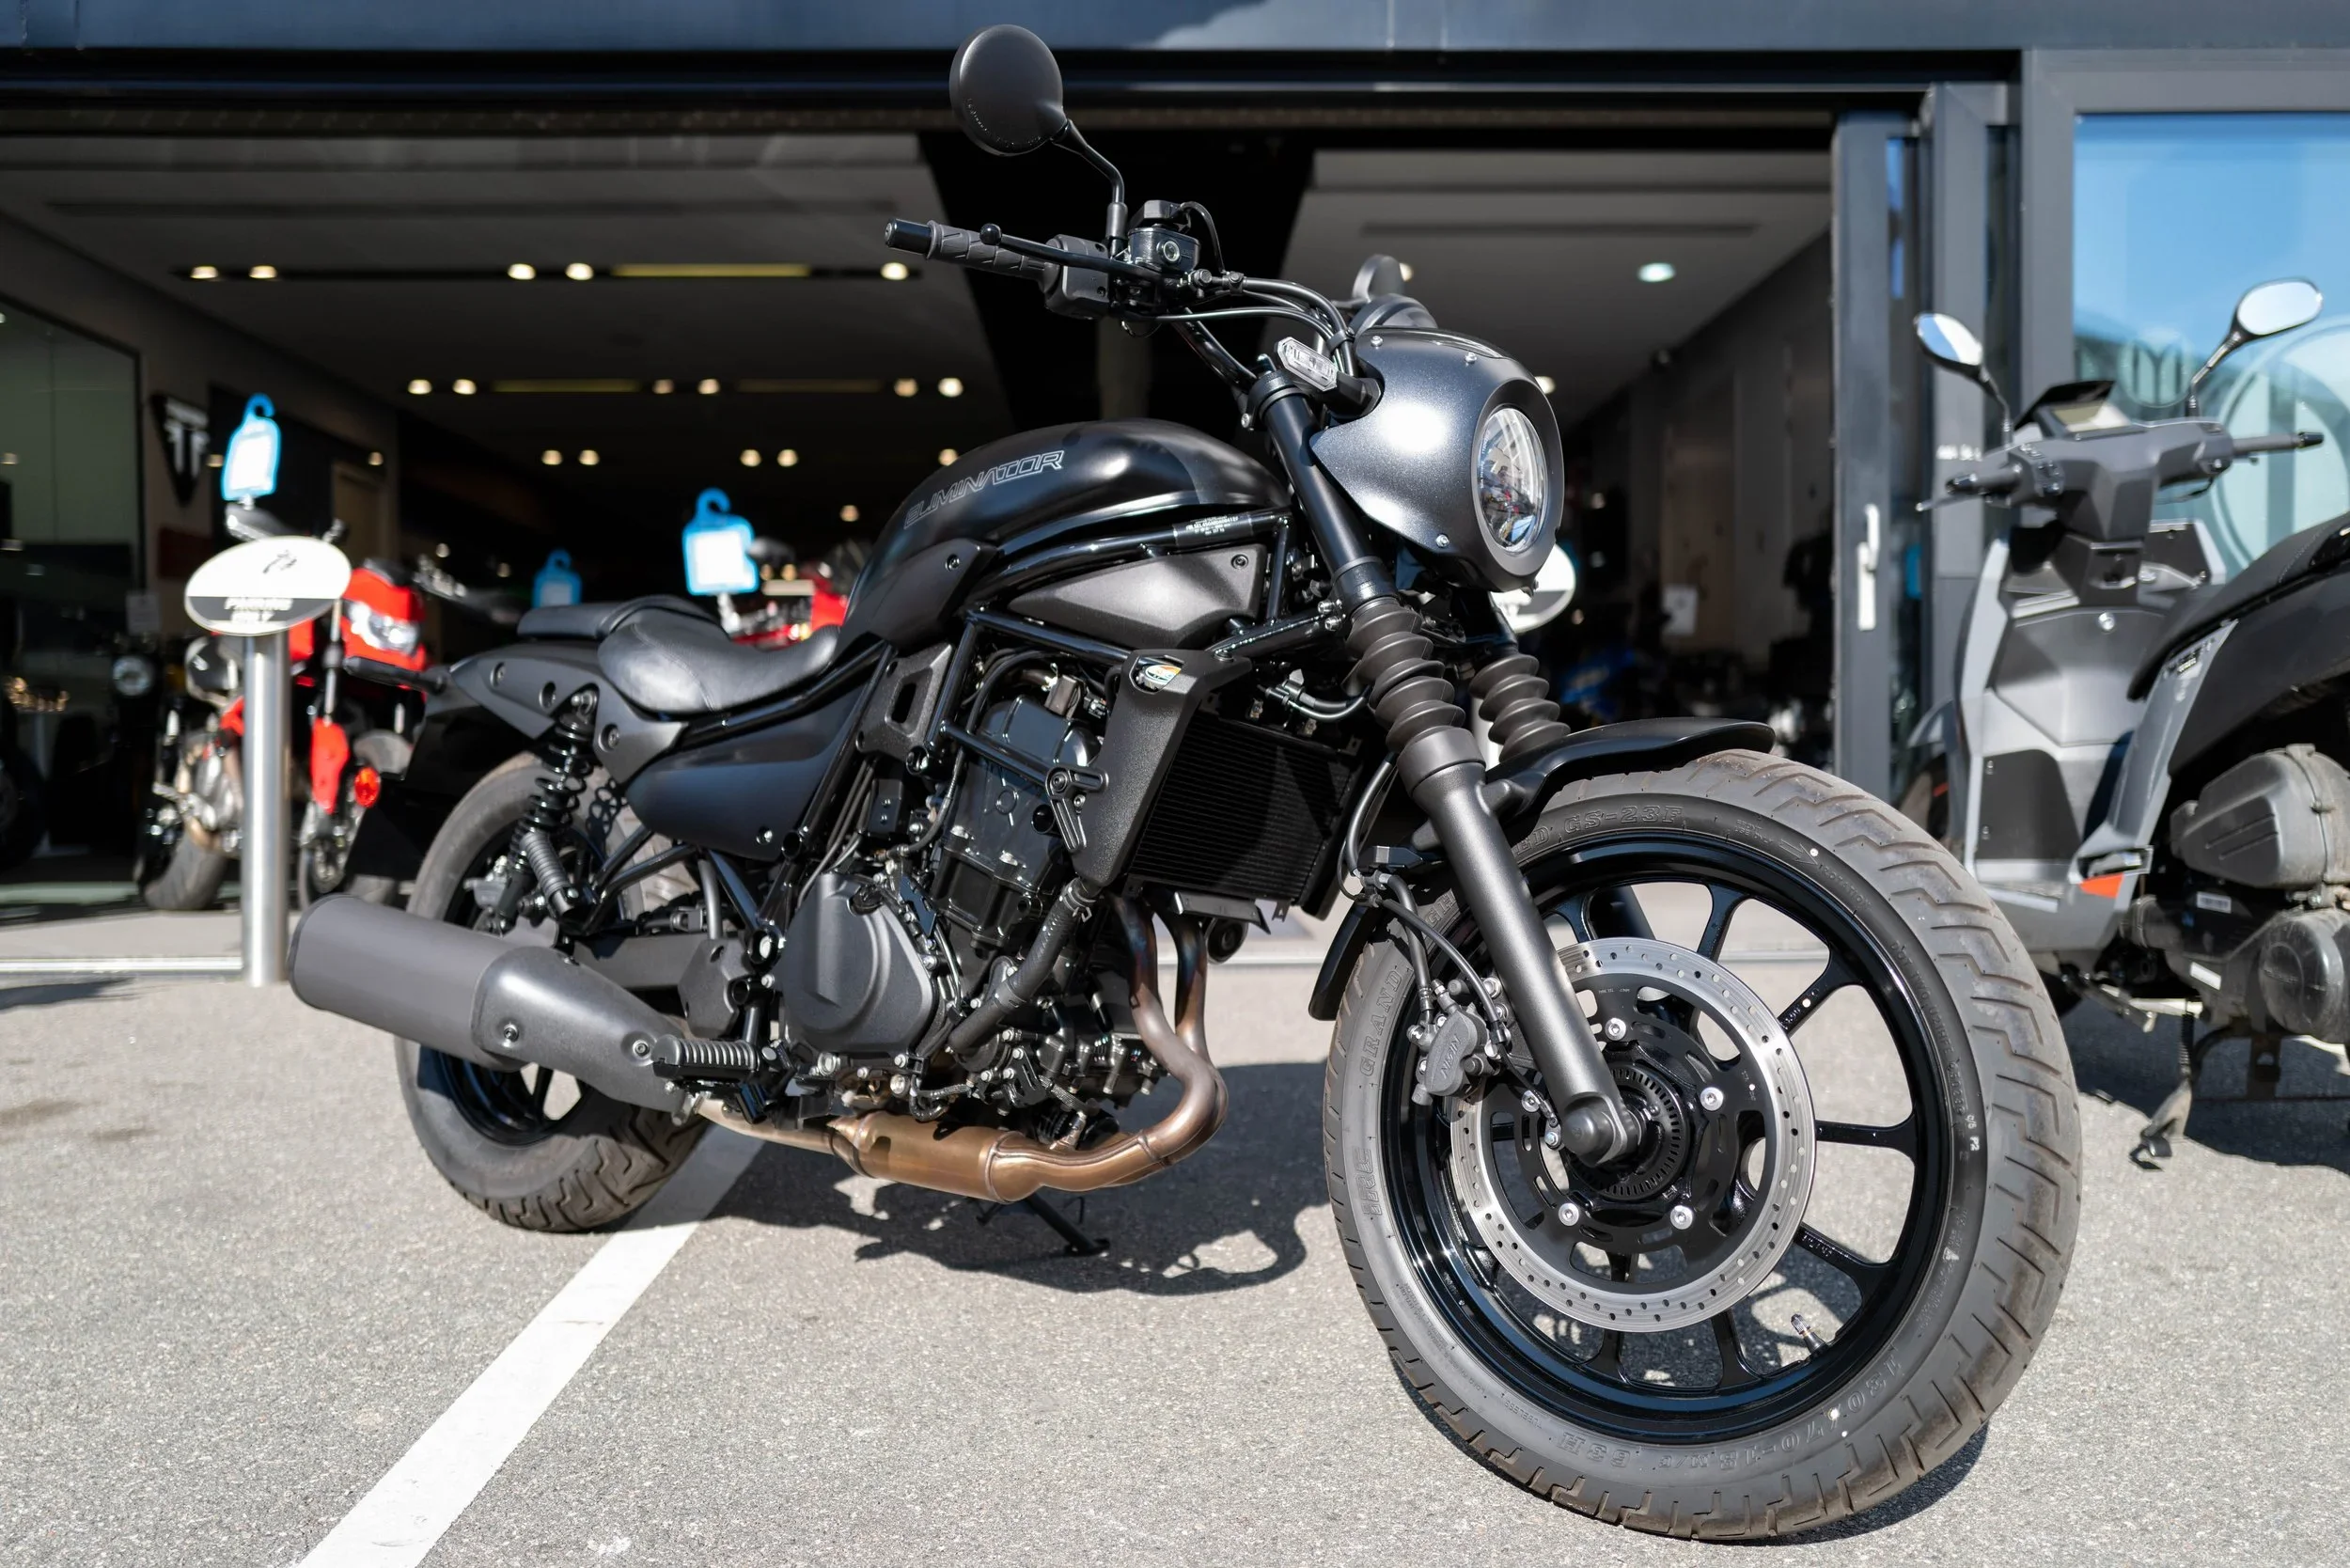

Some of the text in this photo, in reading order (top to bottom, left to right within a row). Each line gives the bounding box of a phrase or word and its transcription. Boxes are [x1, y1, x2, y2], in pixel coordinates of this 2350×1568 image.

[903, 450, 1065, 529] ELIMINATOR
[1564, 804, 1684, 834] GS-23F
[1360, 969, 1402, 1077] GRAND
[1556, 1431, 1632, 1468] 63H
